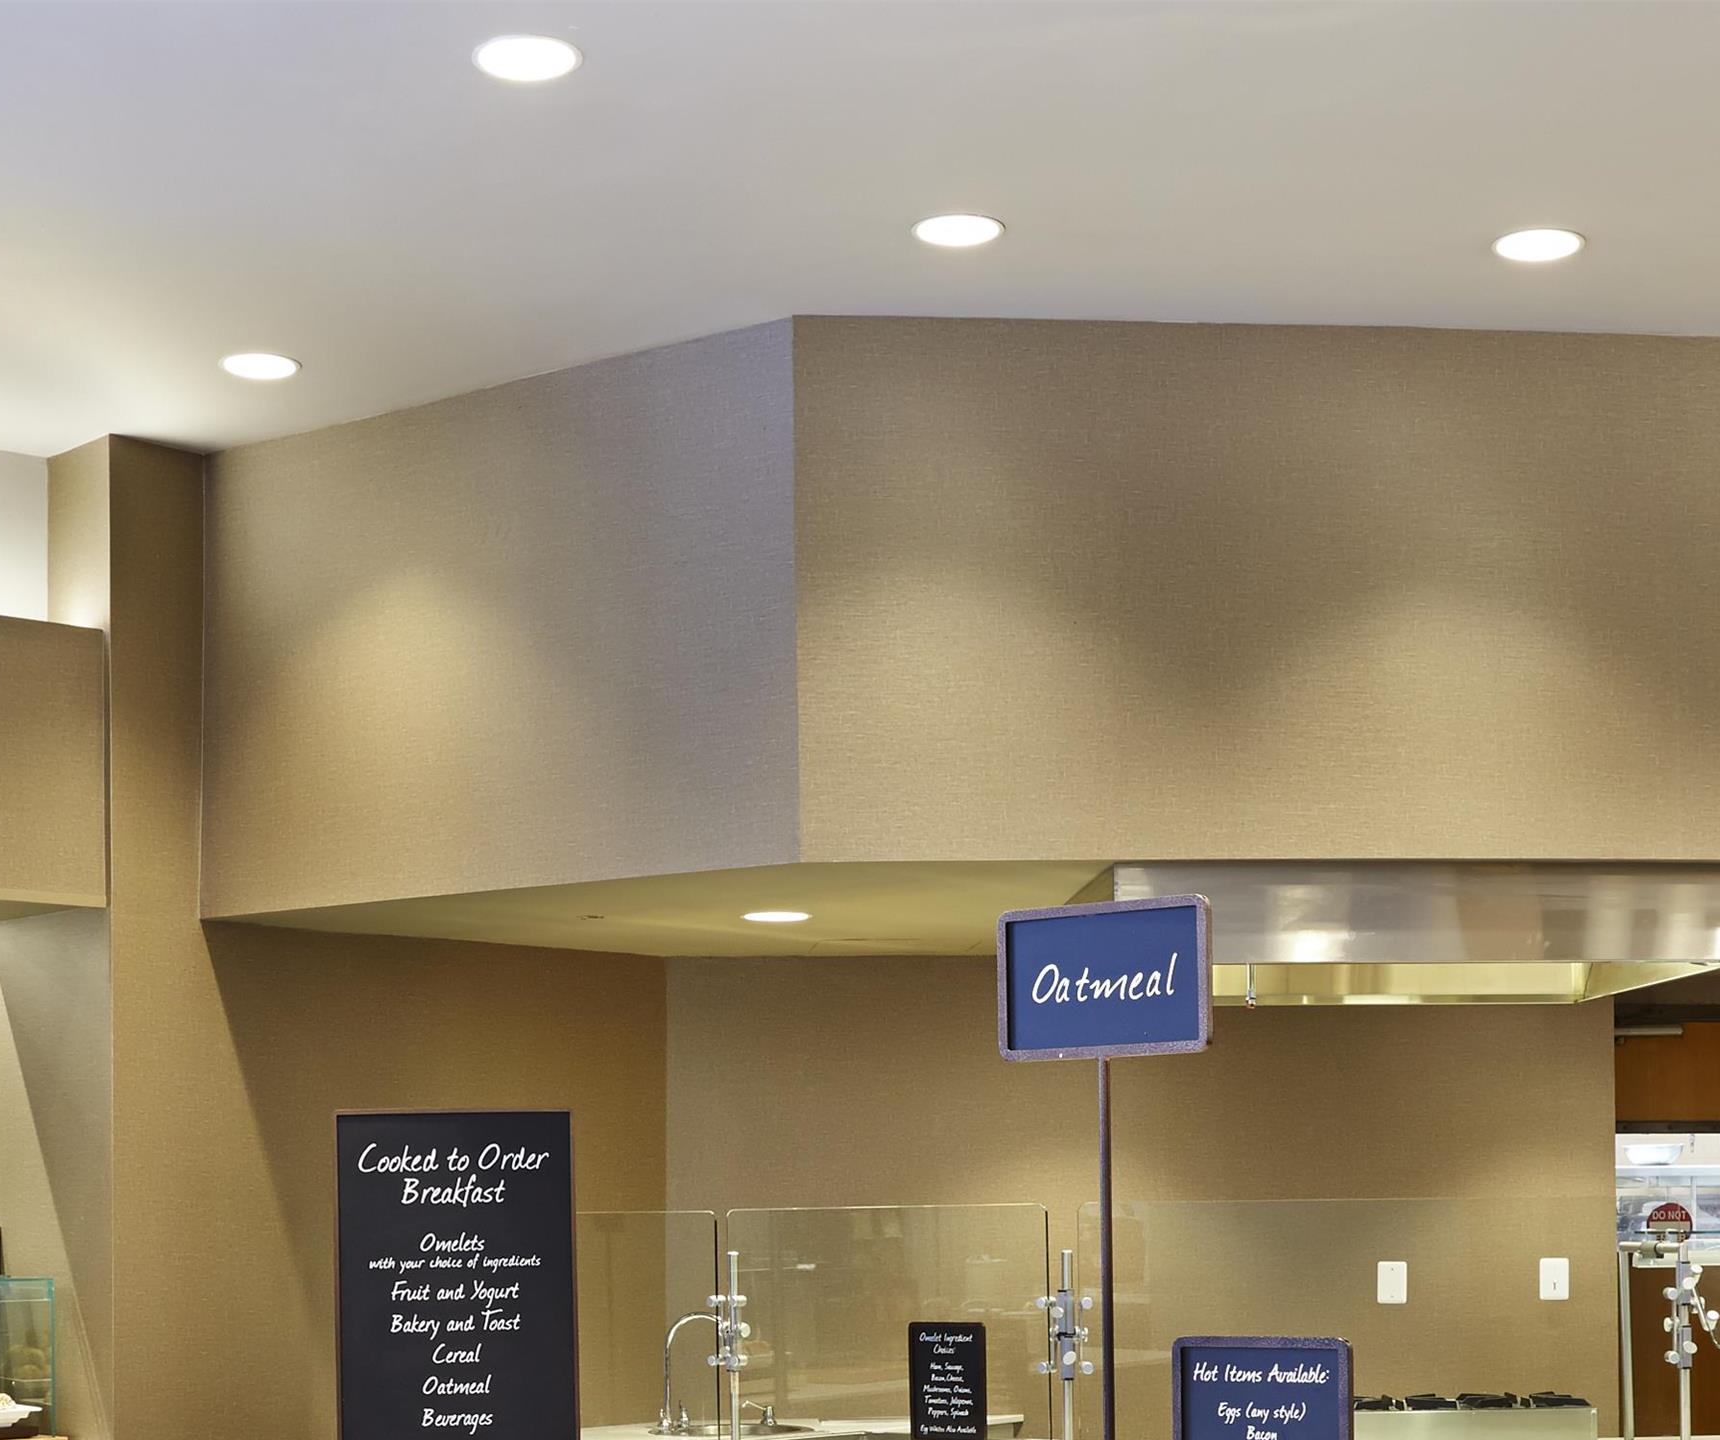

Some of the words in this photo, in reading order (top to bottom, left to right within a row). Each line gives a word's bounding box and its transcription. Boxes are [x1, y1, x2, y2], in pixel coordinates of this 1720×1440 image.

[1032, 953, 1177, 1003] Oatmeal
[358, 1143, 439, 1172] Cooked
[447, 1148, 469, 1171] to
[478, 1144, 549, 1170] Order
[401, 1174, 505, 1207] Breakfast
[1652, 1210, 1666, 1220] DO
[1668, 1210, 1686, 1220] NOT
[420, 1232, 484, 1252] Omelets
[369, 1257, 395, 1269] with
[400, 1260, 425, 1274] your
[430, 1256, 462, 1268] choice
[467, 1253, 479, 1269] of
[483, 1255, 540, 1273] ingredients
[391, 1281, 430, 1301] Fruit
[437, 1284, 465, 1300] and
[470, 1280, 519, 1308] Yogurt
[391, 1314, 440, 1340] Bakery
[447, 1315, 475, 1331] and
[481, 1309, 520, 1331] Toast
[433, 1343, 481, 1363] Cereal
[1193, 1362, 1218, 1381] Hot
[1225, 1364, 1262, 1383] Items
[1267, 1364, 1329, 1383] Available:
[423, 1375, 491, 1394] Oatmeal
[422, 1409, 493, 1434] Beverages
[1218, 1402, 1241, 1424] Eggs
[1246, 1402, 1269, 1424] (any
[1274, 1402, 1306, 1424] style)
[1247, 1426, 1277, 1440] Bacon
